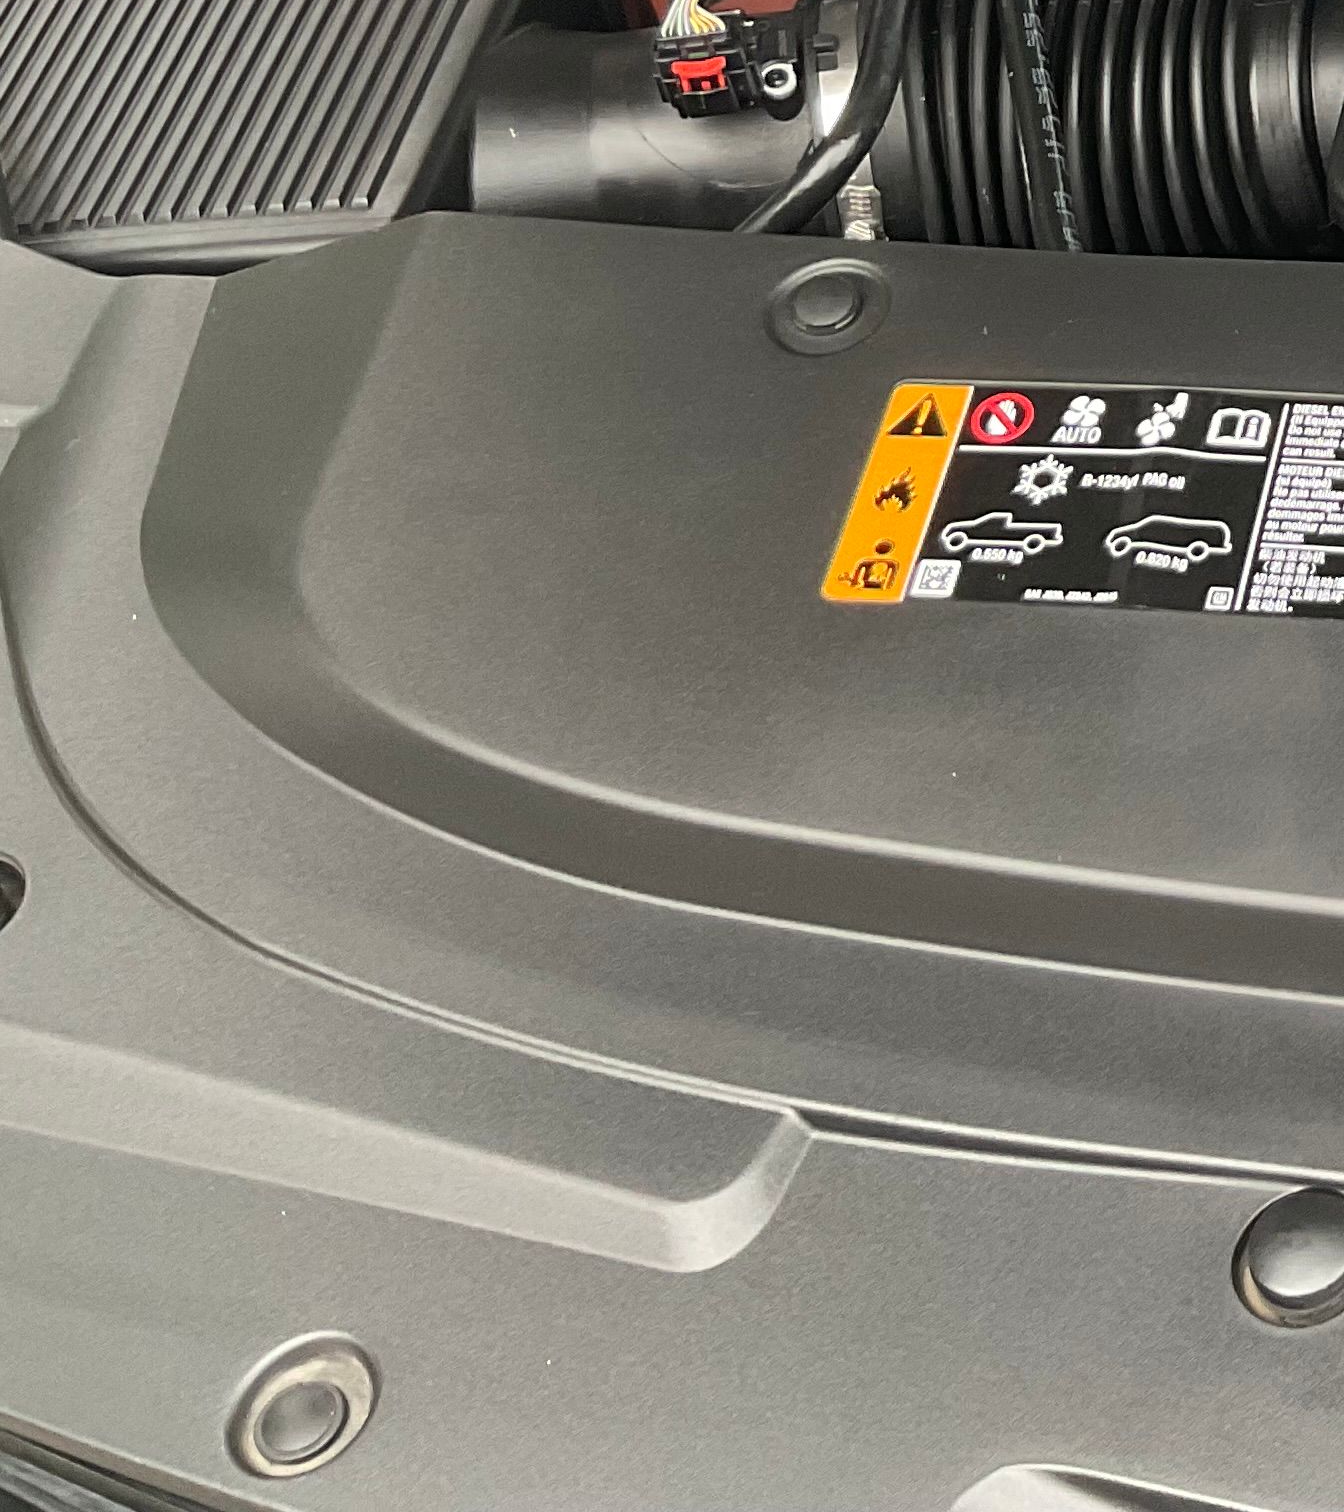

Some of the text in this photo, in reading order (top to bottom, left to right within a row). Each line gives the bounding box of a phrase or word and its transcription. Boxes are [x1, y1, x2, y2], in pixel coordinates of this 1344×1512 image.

[1292, 403, 1329, 416] DIESEL
[1050, 425, 1102, 443] AUTO
[1287, 425, 1303, 436] Do
[1303, 426, 1322, 437] not
[1322, 428, 1343, 439] use
[1282, 447, 1303, 457] can
[1278, 463, 1323, 477] MOTEUR
[1141, 472, 1169, 487] PAG
[1168, 474, 1187, 490] oil
[1272, 486, 1289, 498] Ne
[1007, 550, 1024, 567] kg
[1170, 555, 1189, 573] kg
